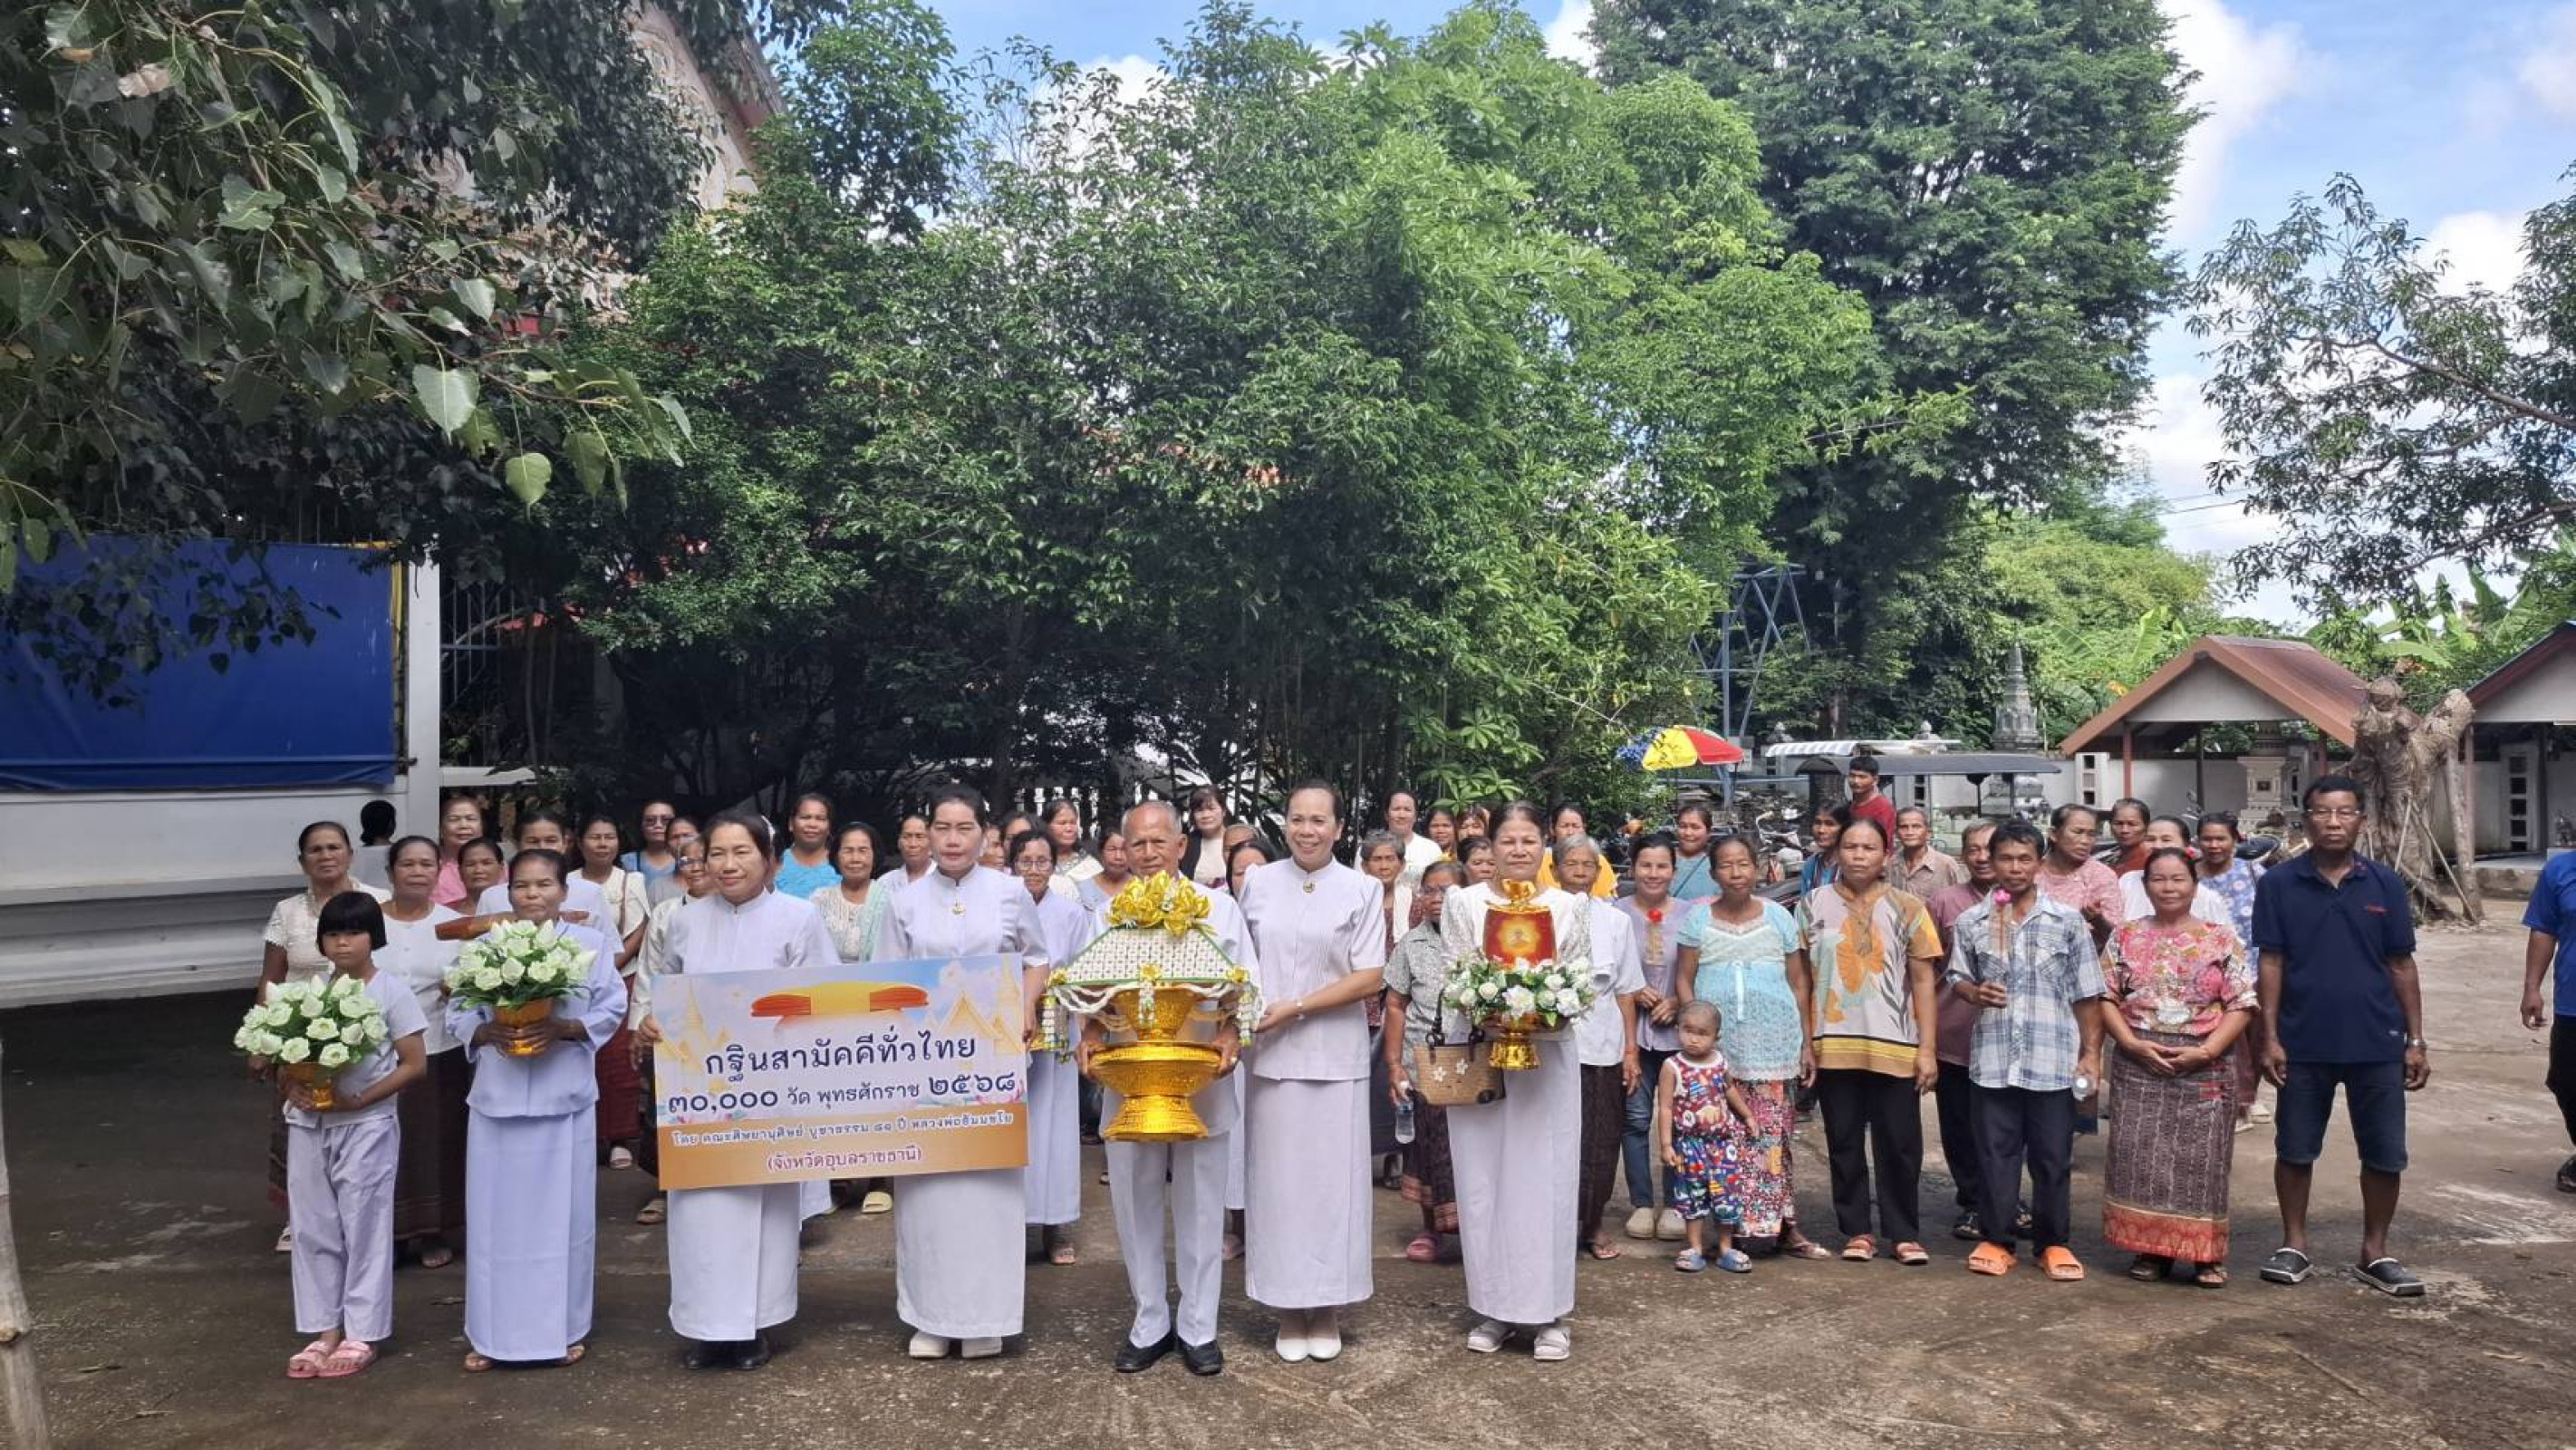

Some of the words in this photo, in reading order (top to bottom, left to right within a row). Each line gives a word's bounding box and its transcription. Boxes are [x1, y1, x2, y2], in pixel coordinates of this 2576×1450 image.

[705, 1025, 976, 1082] กฐินสามัคคีทั่วไทย
[669, 1090, 778, 1114] ๓๐,๐๐๐
[787, 1087, 811, 1105] วัด
[817, 1083, 920, 1110] พุทธศักราช
[929, 1072, 1016, 1096] ๒๕๖๘
[673, 1131, 698, 1146] โดย
[702, 1124, 803, 1142] คณะศิษยานุศิษย์
[809, 1122, 869, 1139] บูชาธรรม
[898, 1116, 907, 1130] ปี
[767, 1145, 921, 1171] (จังหวัดอุบลราชธานี)
